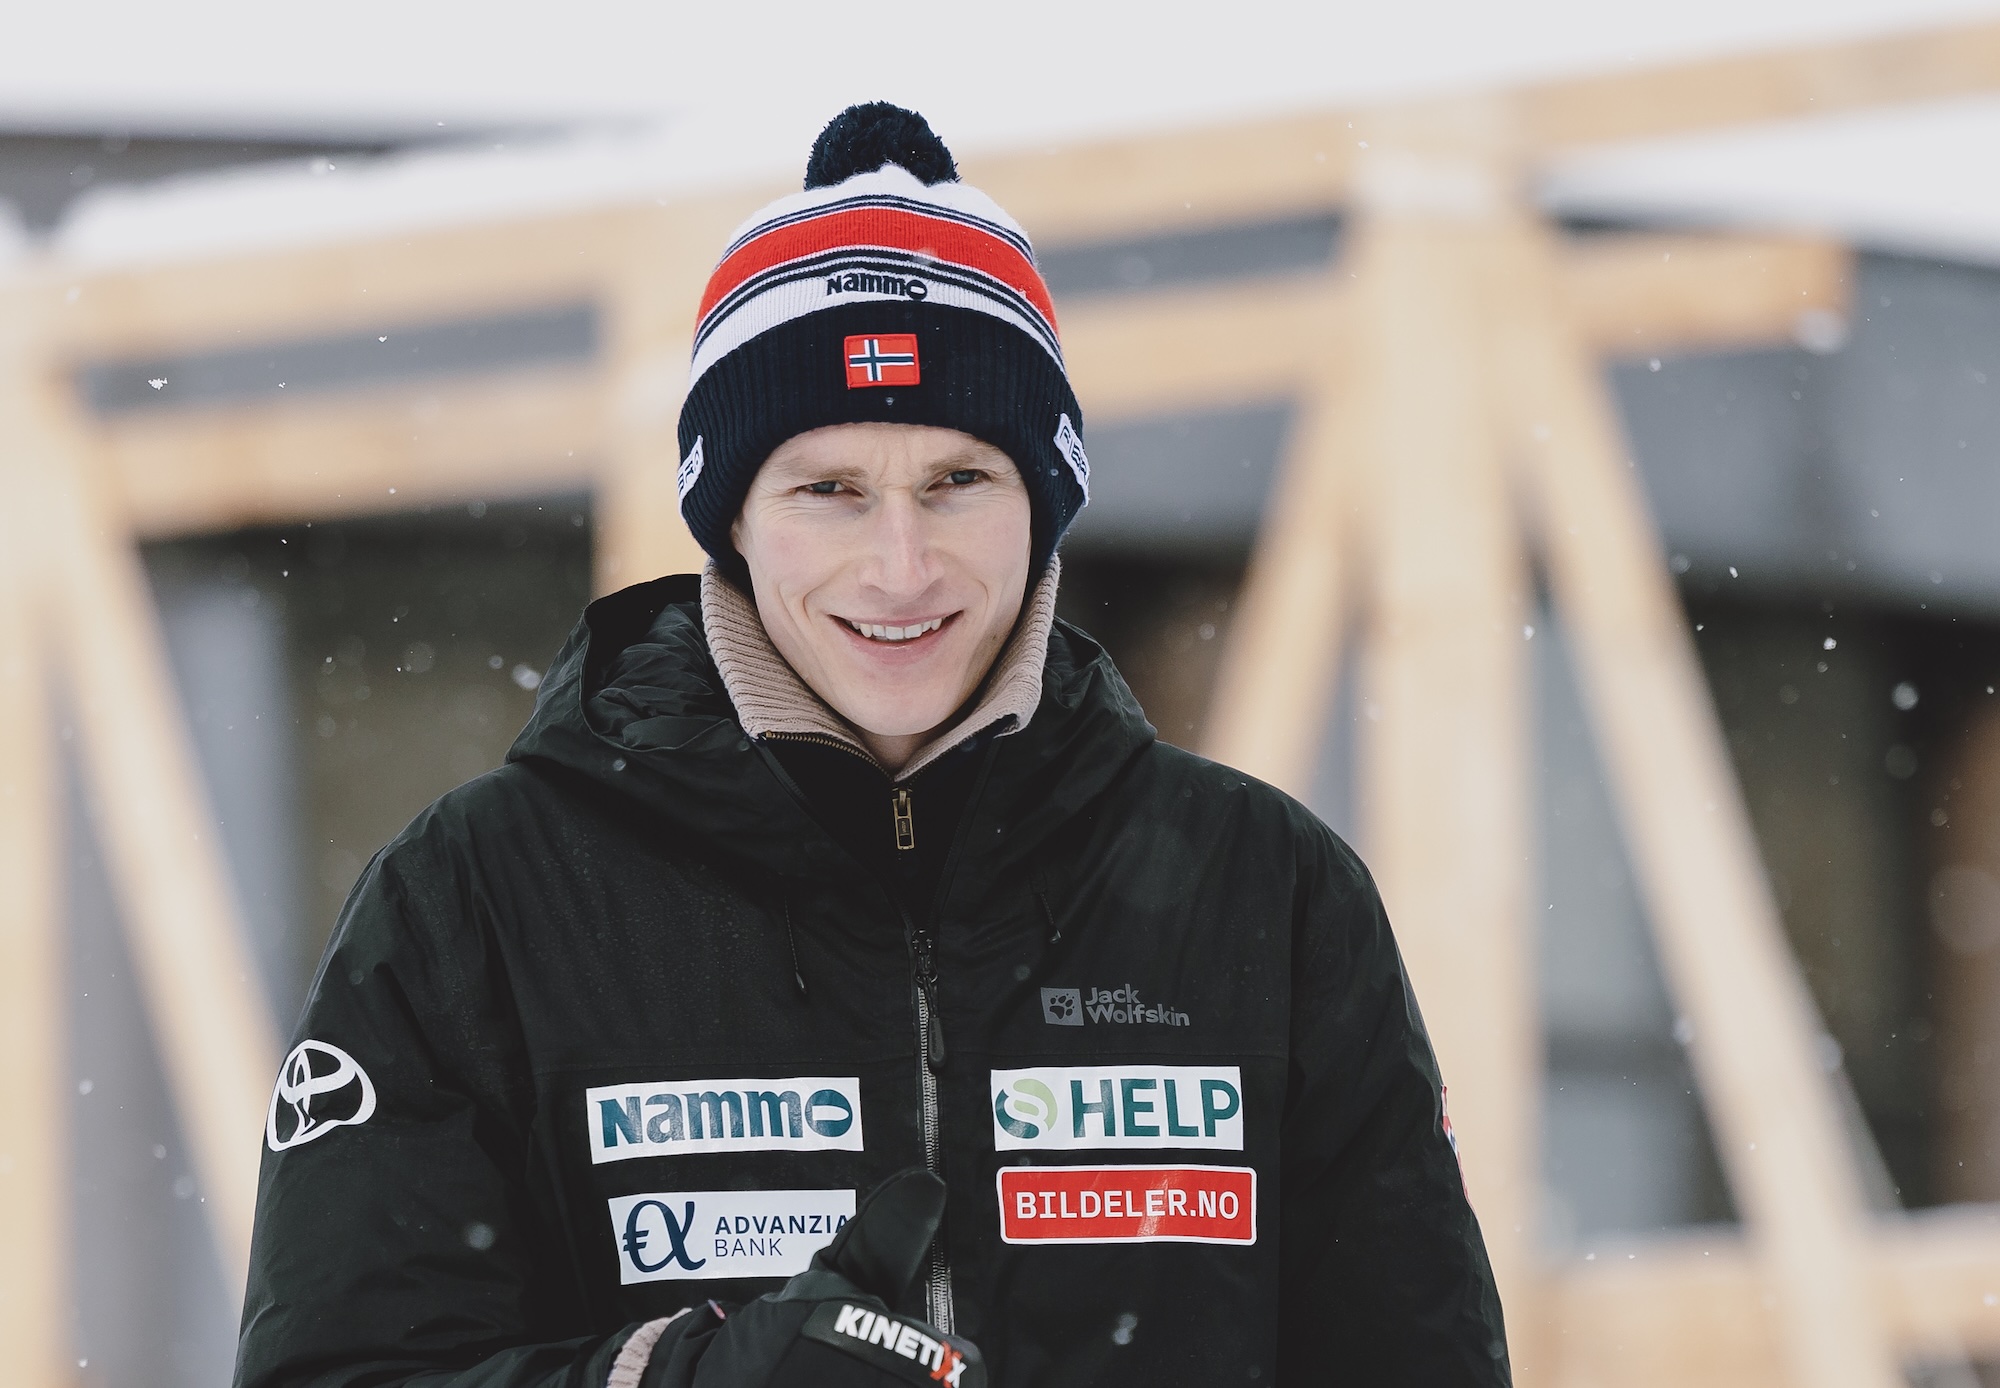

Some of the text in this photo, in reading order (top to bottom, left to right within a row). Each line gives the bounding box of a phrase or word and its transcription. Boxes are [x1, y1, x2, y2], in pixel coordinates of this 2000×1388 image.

[826, 273, 928, 301] Nammo
[1085, 984, 1141, 1006] Jack
[1085, 1003, 1191, 1027] Wolfskin
[595, 1088, 853, 1149] Nammo
[1069, 1078, 1241, 1139] HELP
[1015, 1188, 1240, 1220] BILDELER.NO
[714, 1214, 850, 1236] ADVANZIA
[714, 1237, 783, 1258] BANK
